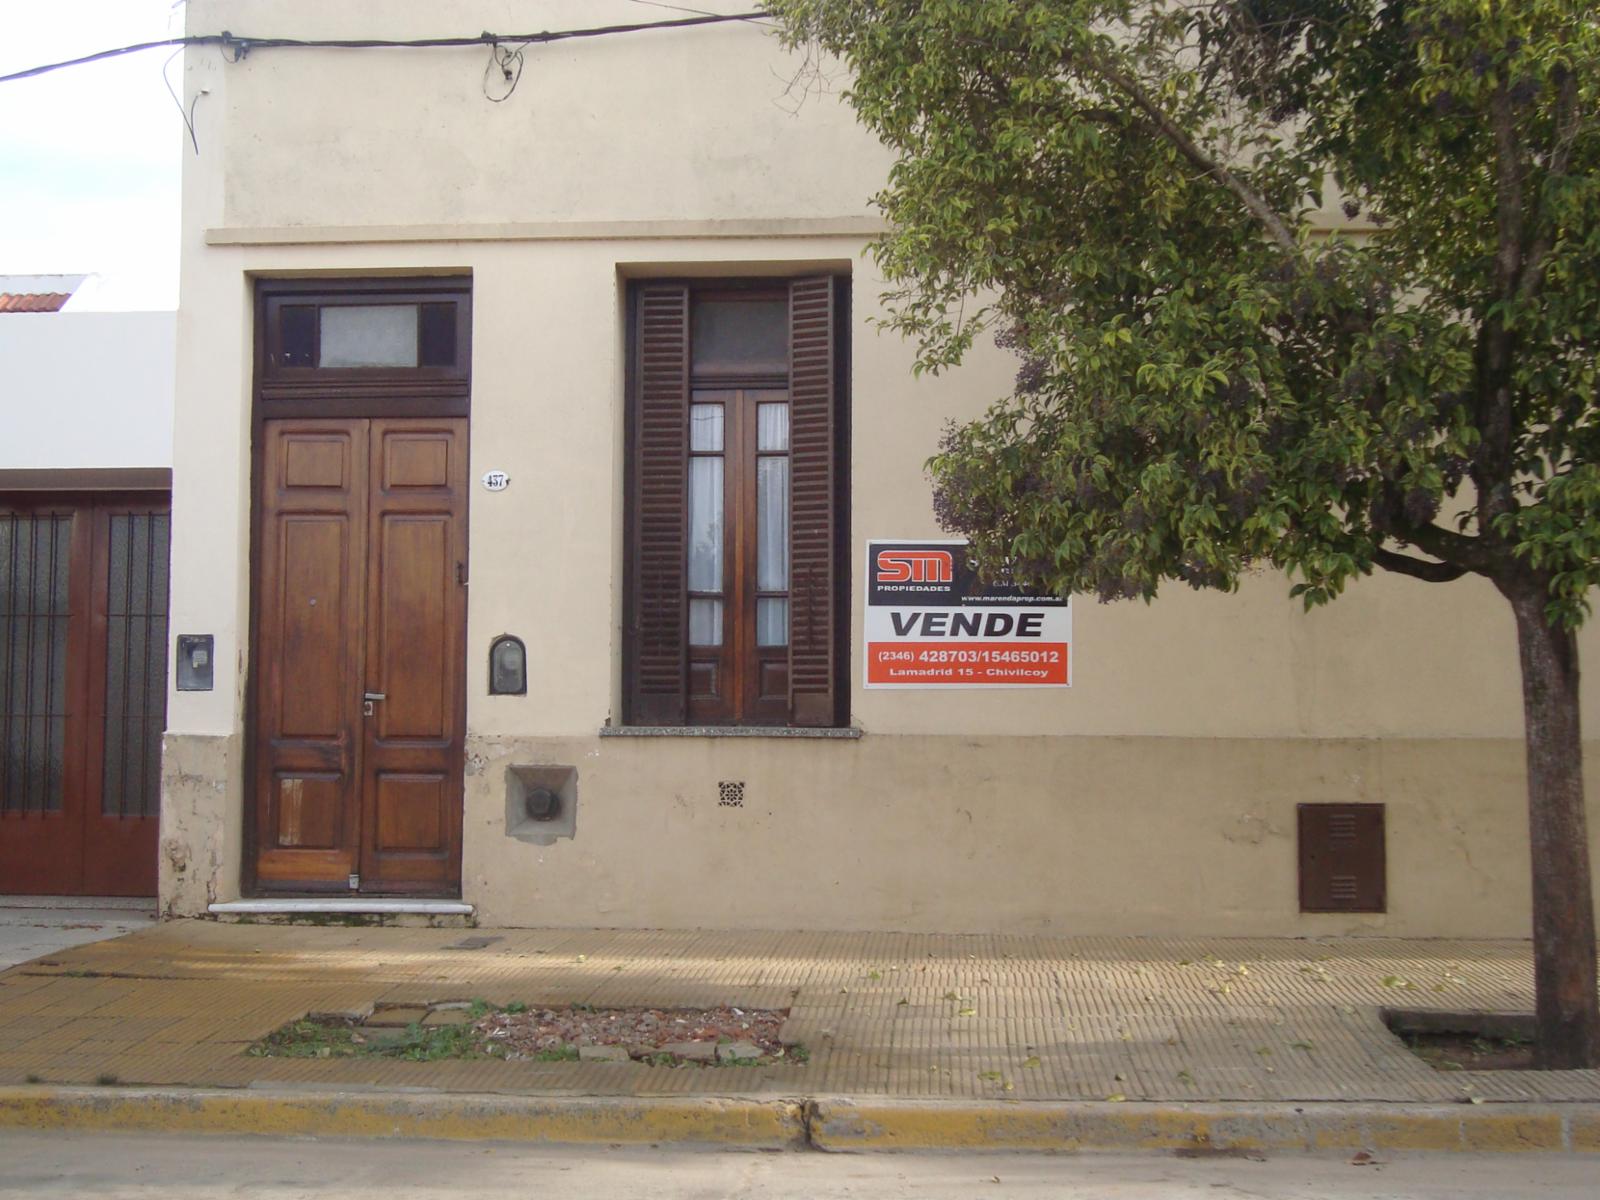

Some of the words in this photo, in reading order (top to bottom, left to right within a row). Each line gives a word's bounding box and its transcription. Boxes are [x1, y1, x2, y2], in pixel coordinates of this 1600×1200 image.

[890, 612, 1045, 637] VENDE
[878, 650, 915, 662] (2346)
[919, 650, 1059, 662] 428703/15465012
[889, 668, 953, 676] Lamadrid
[957, 668, 974, 676] 15
[986, 668, 1049, 678] Chivilcoy
